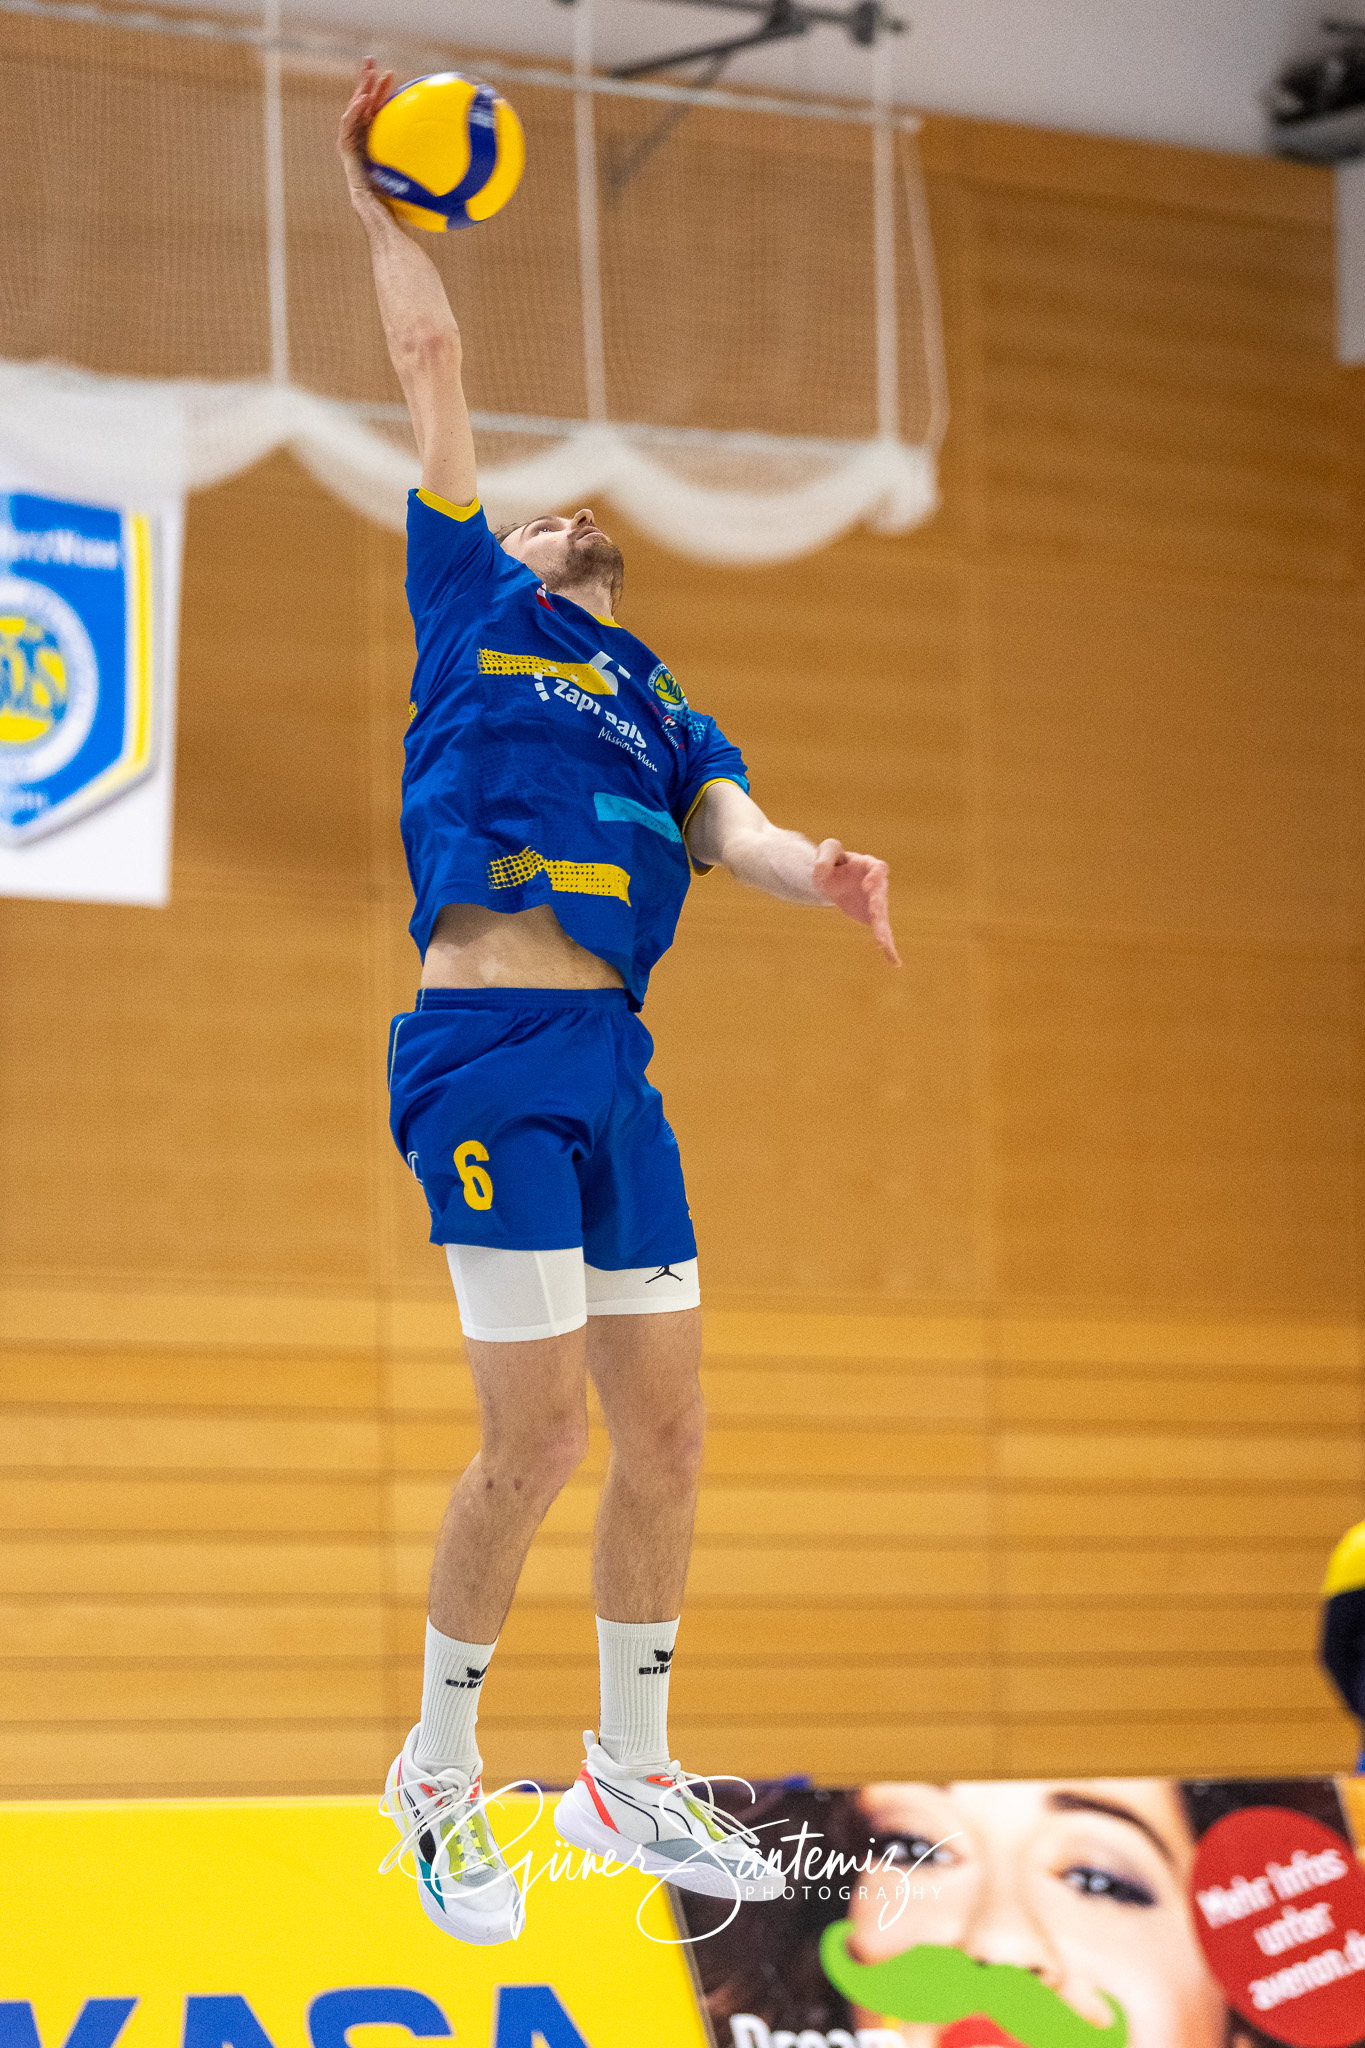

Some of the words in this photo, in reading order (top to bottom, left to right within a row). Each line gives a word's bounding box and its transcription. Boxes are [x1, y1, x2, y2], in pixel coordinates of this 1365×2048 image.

[453, 1139, 494, 1211] 6
[1197, 1874, 1277, 1930] Mehr
[1266, 1849, 1349, 1901] Infos
[1254, 1902, 1335, 1957] unter
